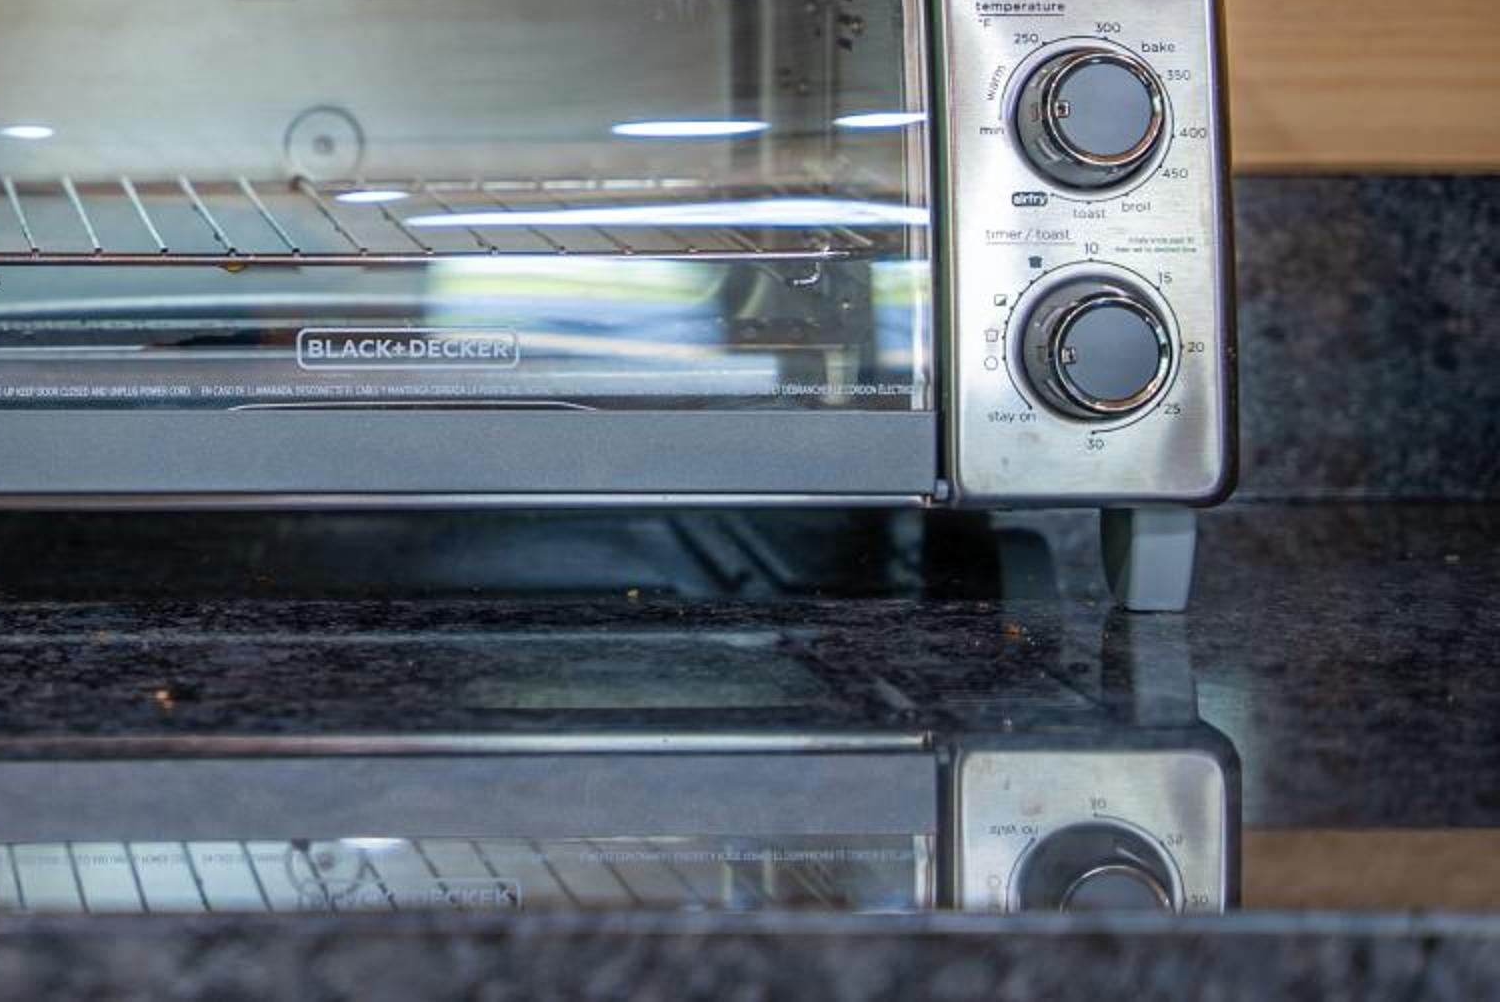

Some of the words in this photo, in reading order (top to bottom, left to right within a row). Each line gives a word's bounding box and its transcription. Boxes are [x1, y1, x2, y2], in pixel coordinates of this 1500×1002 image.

[975, 0, 1066, 12] temperature
[1094, 21, 1122, 34] 300
[1013, 33, 1039, 45] 250
[1141, 40, 1176, 53] bake
[1166, 69, 1191, 81] 350
[986, 64, 1006, 101] warm
[979, 125, 1005, 136] min
[1179, 127, 1208, 139] 400
[1162, 168, 1189, 180] 450
[1072, 207, 1107, 219] toast
[1121, 201, 1152, 213] broil
[985, 228, 1022, 240] timer
[1035, 229, 1072, 240] toast
[1084, 242, 1099, 255] 10
[1157, 271, 1173, 284] 15
[307, 338, 510, 359] BLACK+DECKER
[1187, 341, 1206, 354] 20
[1163, 403, 1181, 415] 25
[987, 411, 1016, 423] stay
[1019, 412, 1037, 422] on
[1086, 439, 1104, 451] 30
